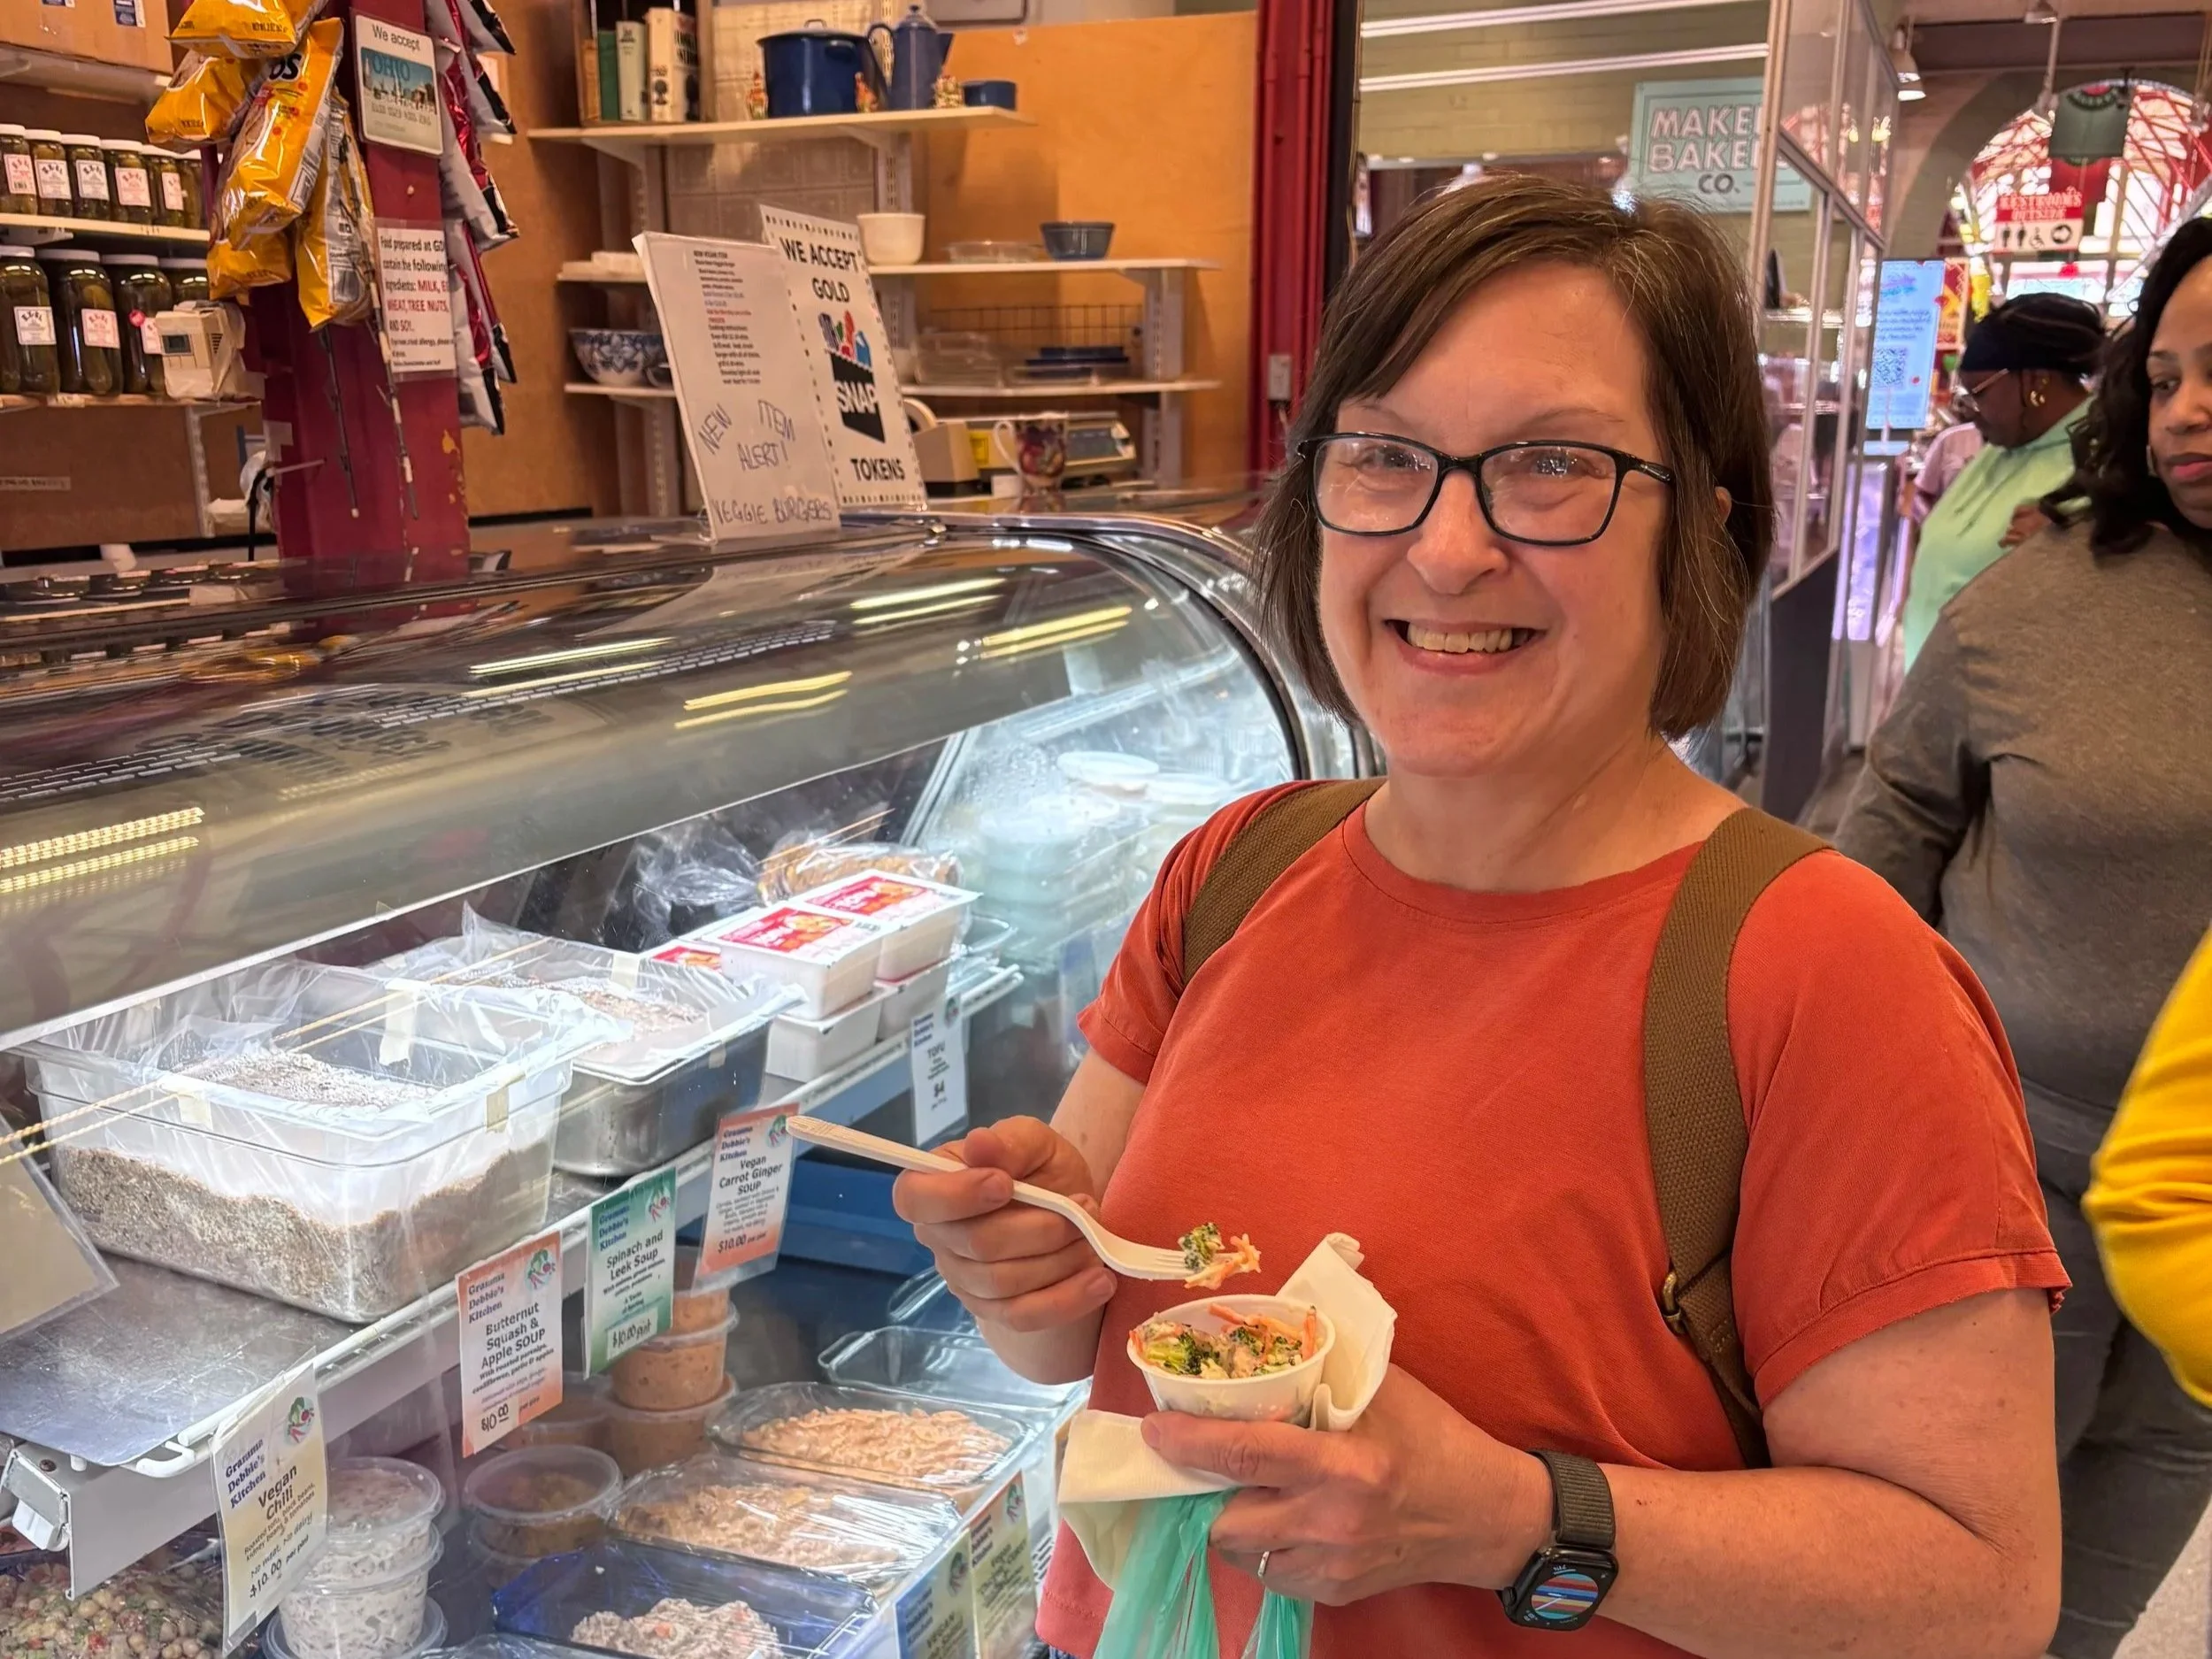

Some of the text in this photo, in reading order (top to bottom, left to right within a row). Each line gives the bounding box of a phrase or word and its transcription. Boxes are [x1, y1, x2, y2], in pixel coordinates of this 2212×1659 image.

[373, 24, 420, 52] We accept
[372, 55, 411, 81] OHIO
[1649, 139, 1760, 172] BAKE
[1698, 173, 1740, 194] CO.
[394, 239, 422, 252] prepared
[780, 236, 858, 273] WE ACCEPT
[418, 280, 441, 293] MILK,
[812, 277, 850, 303] GOLD
[836, 381, 878, 414] SNAP
[698, 399, 795, 455] NEW ITEM
[737, 441, 791, 471] ALERT!
[849, 458, 905, 480] TOKENS
[711, 495, 832, 526] VEGGIE BURGERS
[719, 1150, 747, 1162] Kitchen
[740, 1156, 766, 1169] Vegan
[719, 1164, 782, 1188] Carrot Ginger
[737, 1181, 762, 1195] SOUP
[606, 1229, 663, 1269] Spinach and
[718, 1233, 747, 1254] $10.00
[611, 1248, 658, 1281] Leek Soup
[468, 1302, 503, 1324] Kitchen
[469, 1286, 503, 1310] Debbie's
[486, 1302, 540, 1336] Butternut
[487, 1317, 539, 1351] Squash &
[481, 1328, 546, 1370] Apple SOUP
[226, 1439, 264, 1478] Gramma
[227, 1454, 265, 1494] Debbie's
[258, 1465, 297, 1508] Vegan
[230, 1471, 266, 1509] Kitchen
[266, 1485, 293, 1520] Chili
[289, 1490, 314, 1518] tomatoes
[244, 1528, 266, 1555] Roasted
[250, 1559, 282, 1598] $10.00
